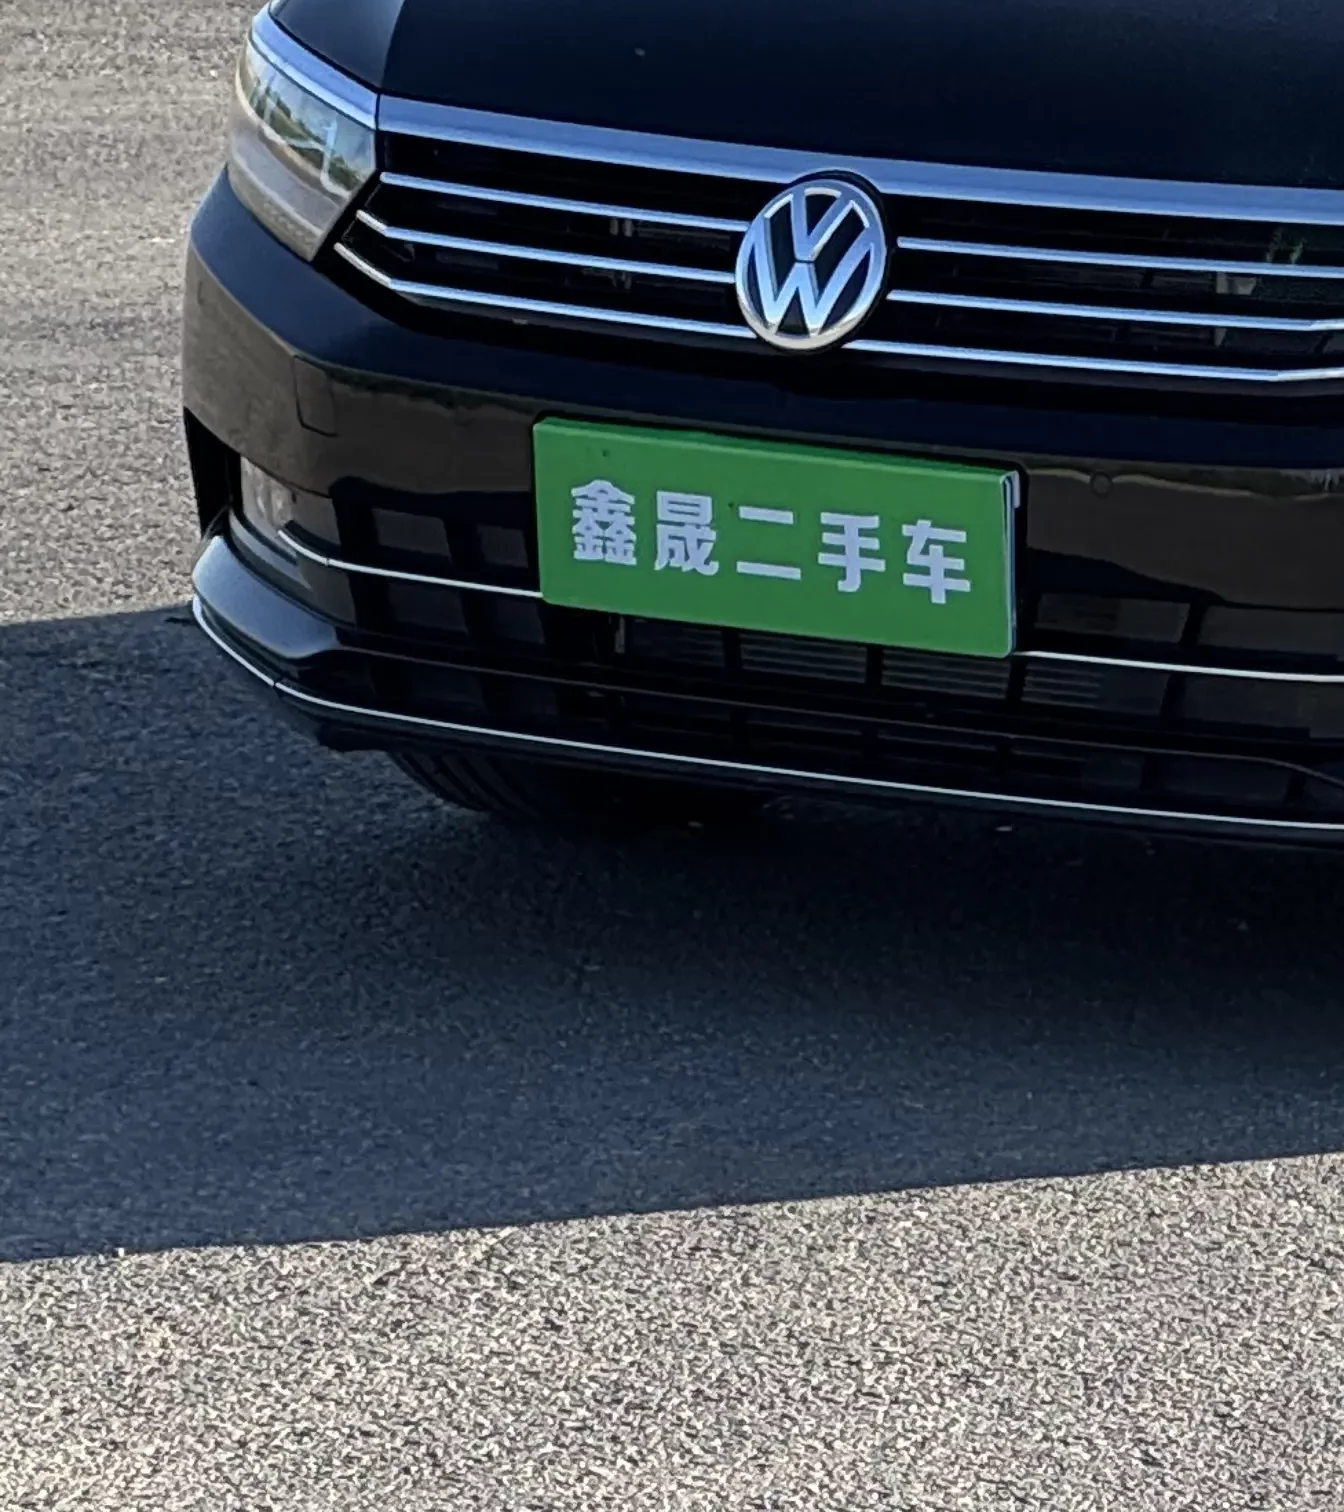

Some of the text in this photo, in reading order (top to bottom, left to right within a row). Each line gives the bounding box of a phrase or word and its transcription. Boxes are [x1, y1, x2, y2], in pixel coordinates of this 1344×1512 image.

[736, 179, 886, 348] VW
[571, 479, 971, 604] 鑫晟二手车
